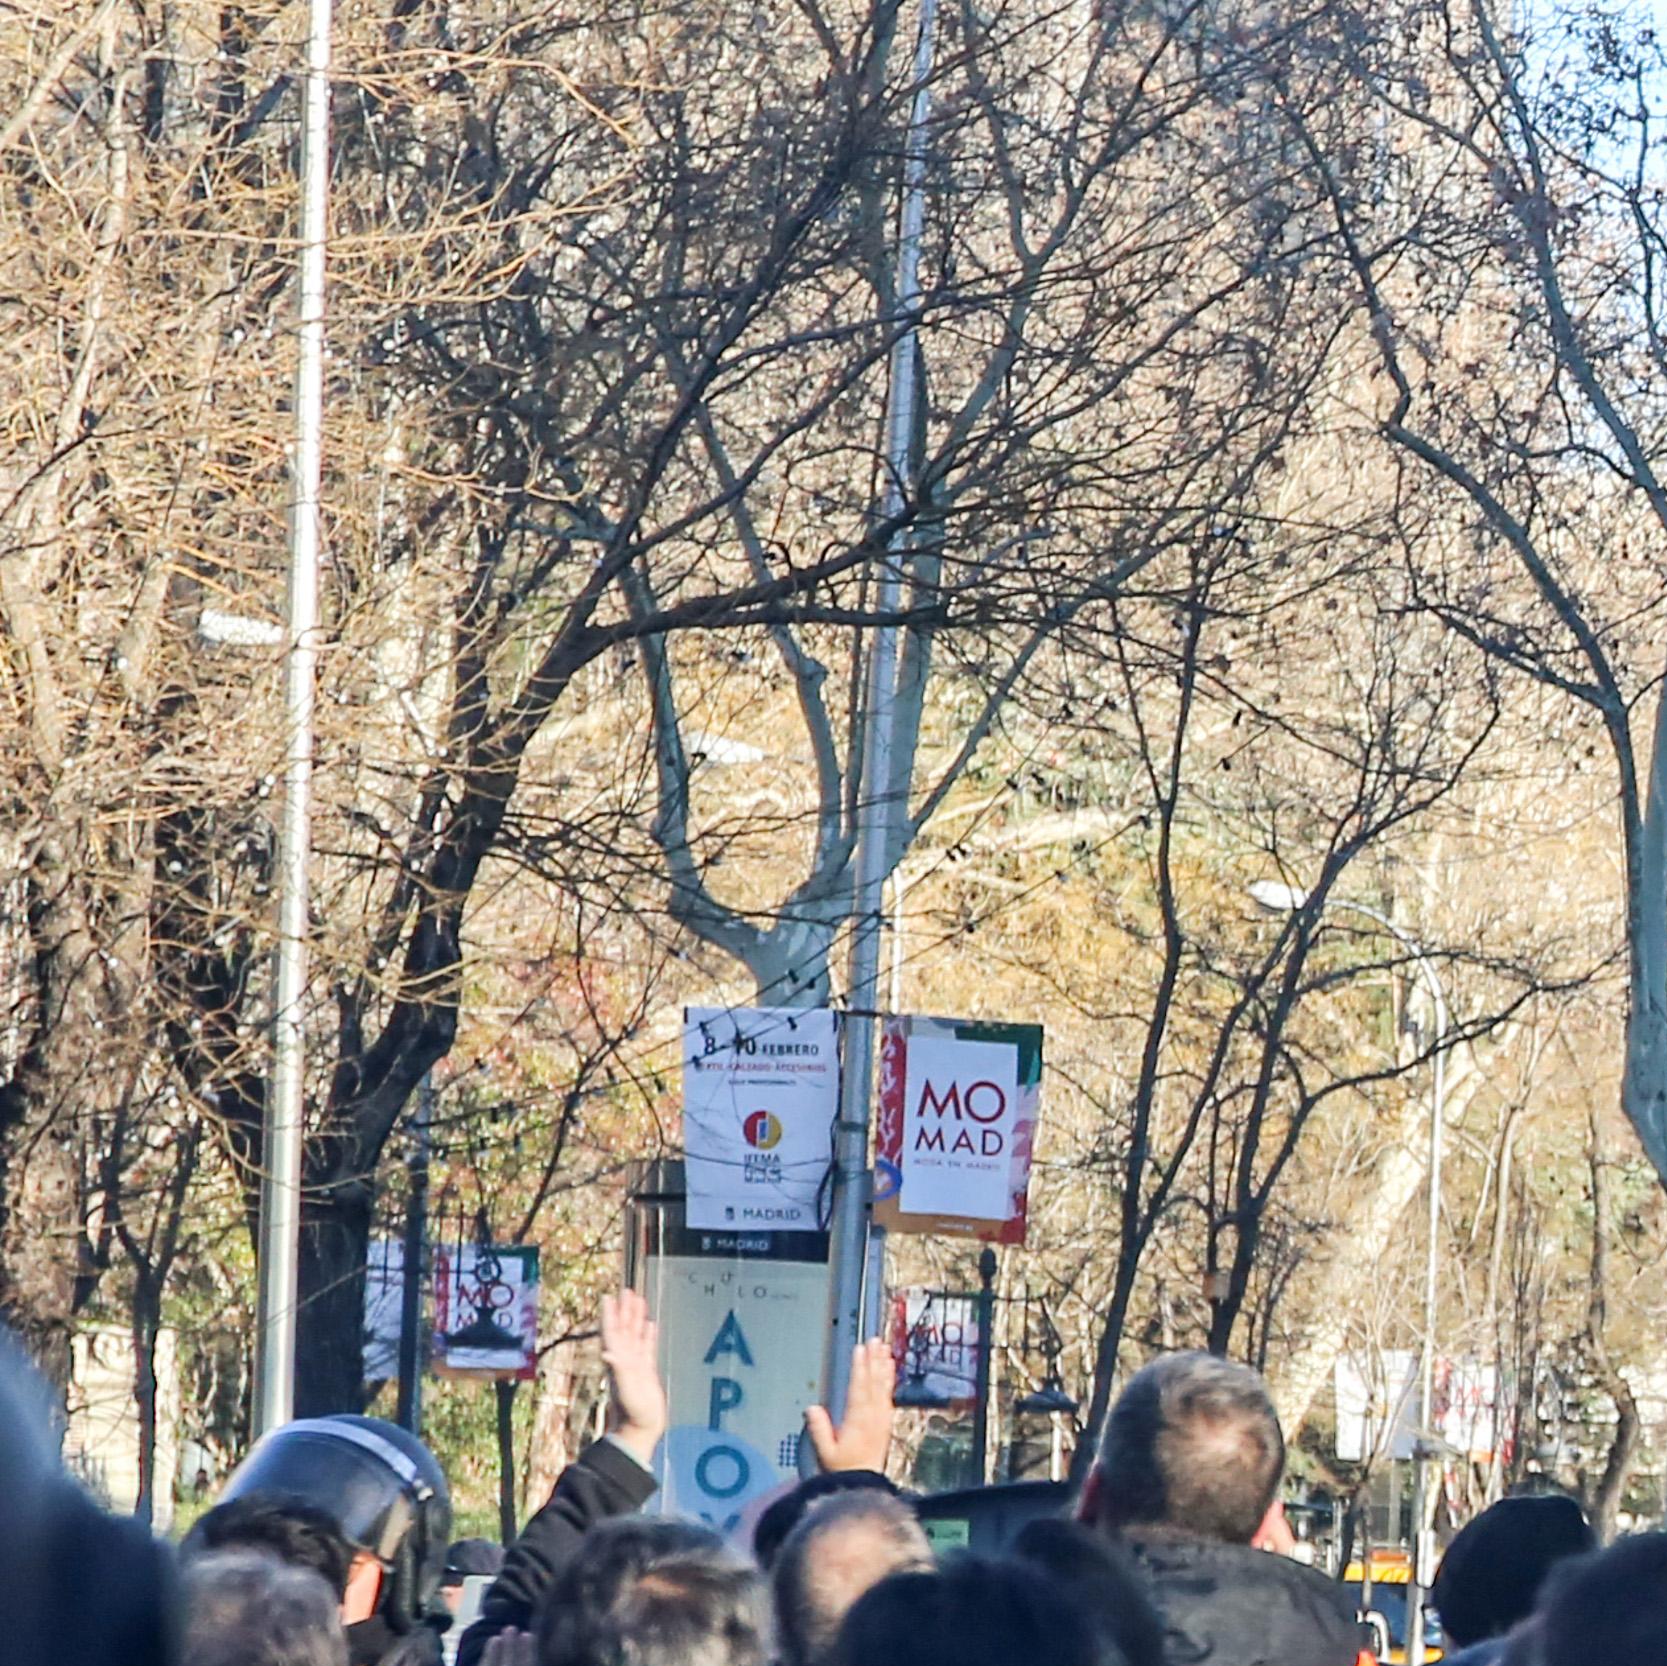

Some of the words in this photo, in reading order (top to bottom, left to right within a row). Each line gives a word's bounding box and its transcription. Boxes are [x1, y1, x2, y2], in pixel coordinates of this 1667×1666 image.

[762, 1044, 820, 1056] FEBRERO
[916, 1078, 1006, 1124] MO
[914, 1124, 1004, 1157] MAD
[743, 1208, 801, 1220] MADRID
[716, 1239, 769, 1250] MADRID
